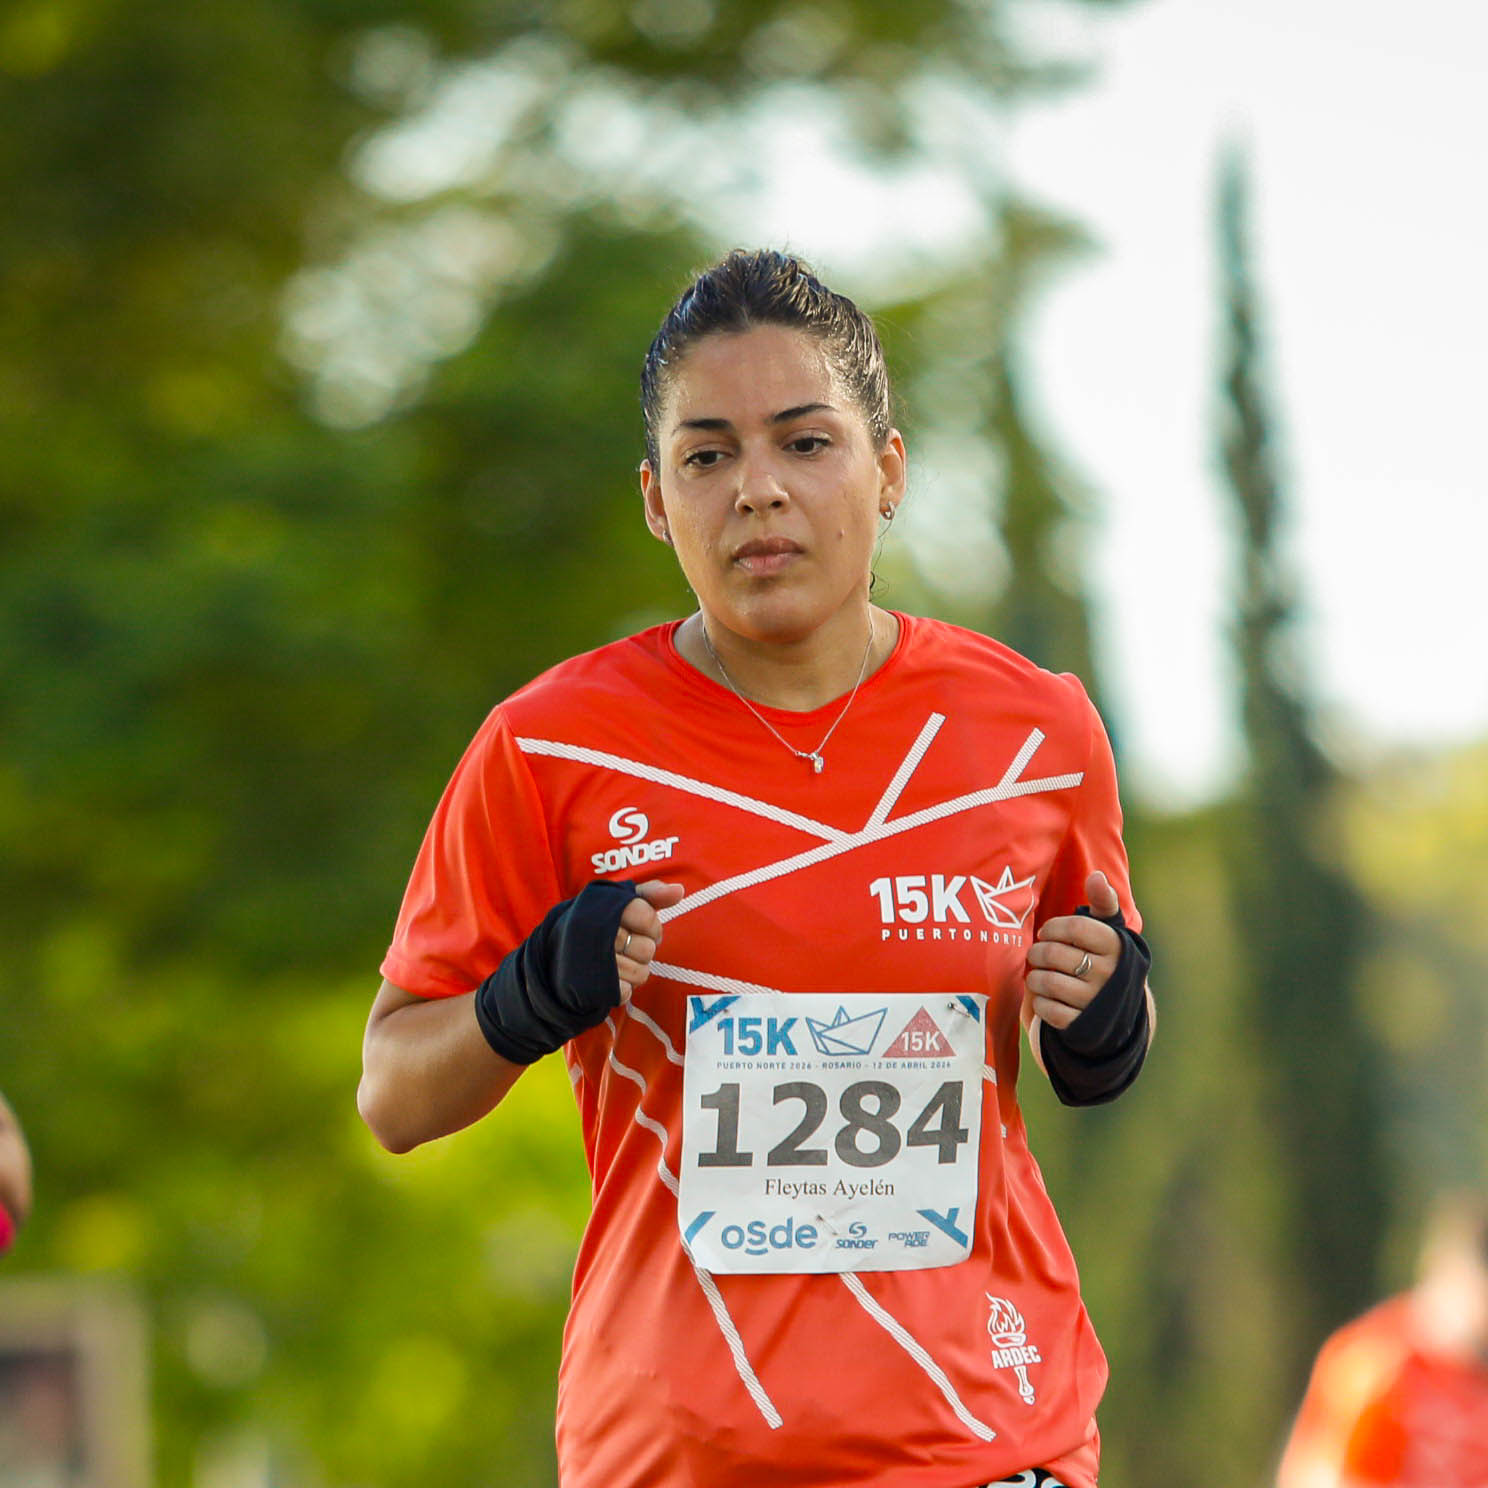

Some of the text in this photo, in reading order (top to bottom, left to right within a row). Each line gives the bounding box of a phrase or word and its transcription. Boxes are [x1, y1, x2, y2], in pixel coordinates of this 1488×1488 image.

[869, 874, 972, 923] 15K
[881, 928, 1023, 948] PUERTO NORTE
[716, 1016, 799, 1056] 15K
[900, 1030, 942, 1052] 15K
[716, 1061, 753, 1070] PUERTO
[756, 1061, 787, 1070] NORTE
[822, 1061, 862, 1070] ROSARIO
[886, 1061, 897, 1070] DE
[901, 1061, 927, 1070] ABRIL
[697, 1080, 969, 1168] 1284
[764, 1178, 895, 1200] Fleytas Ayelén
[720, 1216, 819, 1250] osde
[991, 1345, 1042, 1369] ARDEC
